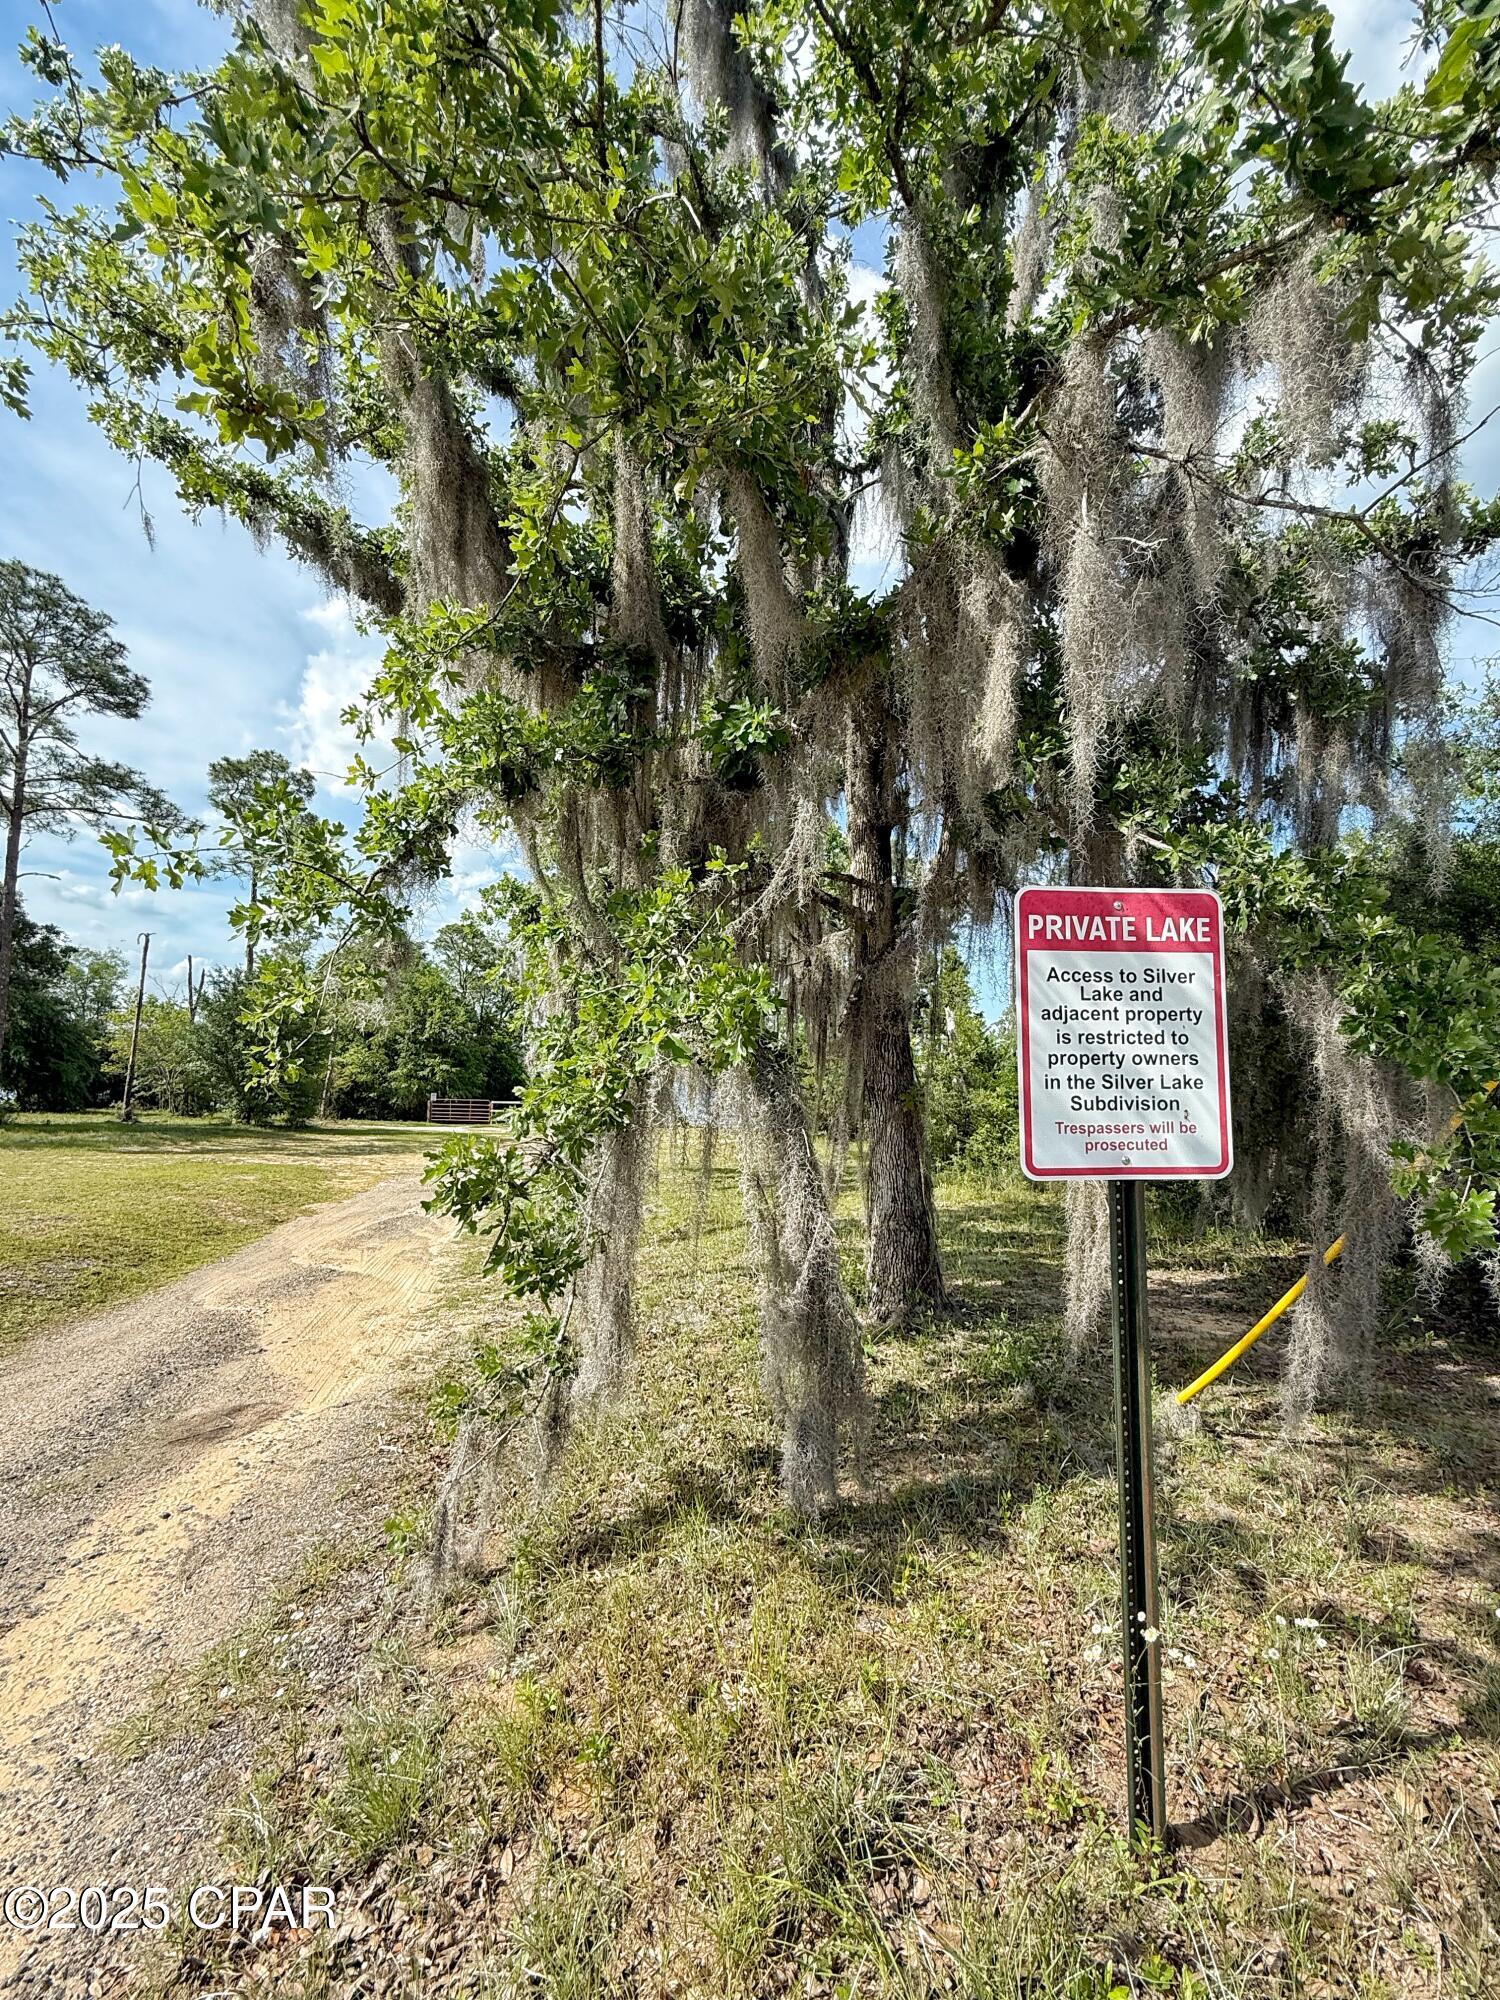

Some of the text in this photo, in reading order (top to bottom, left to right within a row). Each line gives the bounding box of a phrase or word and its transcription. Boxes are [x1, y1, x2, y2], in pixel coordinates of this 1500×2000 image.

[1028, 915, 1211, 941] PRIVATE LAKE
[1047, 967, 1195, 983] Access to Silver
[1081, 986, 1162, 1001] Lake and
[1041, 1006, 1202, 1025] adjacent property
[1056, 1030, 1189, 1045] is restricted to
[1048, 1052, 1199, 1069] property owners
[1045, 1075, 1204, 1090] in the Silver Lake
[1071, 1096, 1179, 1111] Subdivision
[1055, 1122, 1197, 1137] Trespassers will be
[1085, 1139, 1168, 1154] prosecuted
